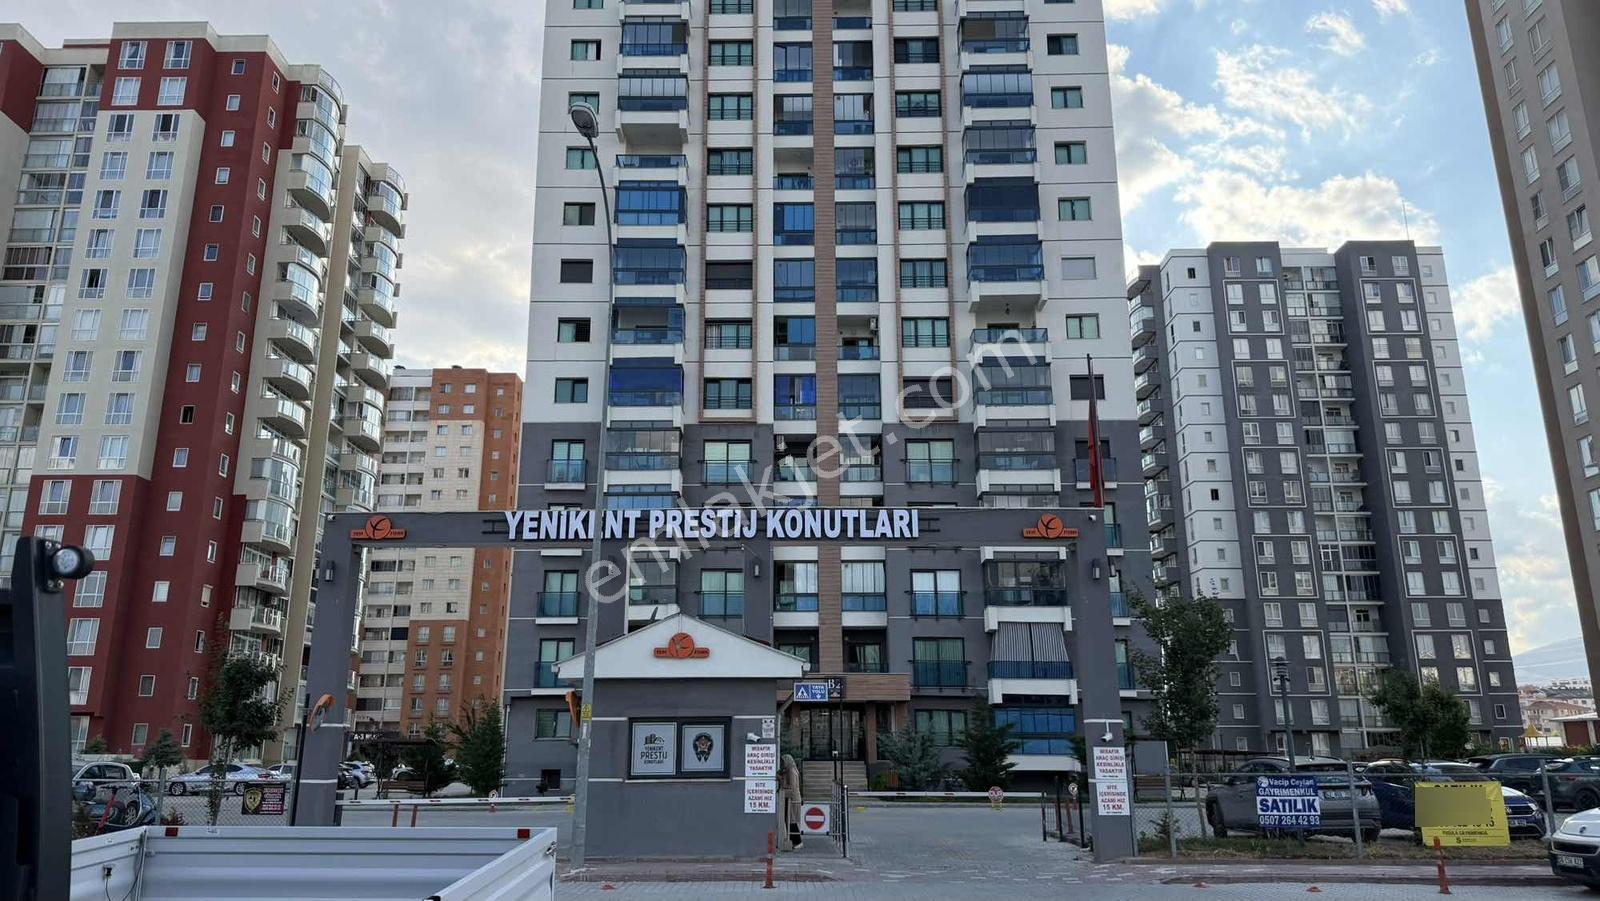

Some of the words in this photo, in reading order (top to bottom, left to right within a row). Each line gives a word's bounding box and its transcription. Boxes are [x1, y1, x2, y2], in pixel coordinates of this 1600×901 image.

[766, 509, 919, 538] KONUTLARI
[1259, 798, 1318, 813] SATILIK
[1259, 815, 1279, 825] 0507
[1281, 815, 1297, 825] 264
[1298, 815, 1308, 825] 42
[1309, 815, 1320, 825] 93
